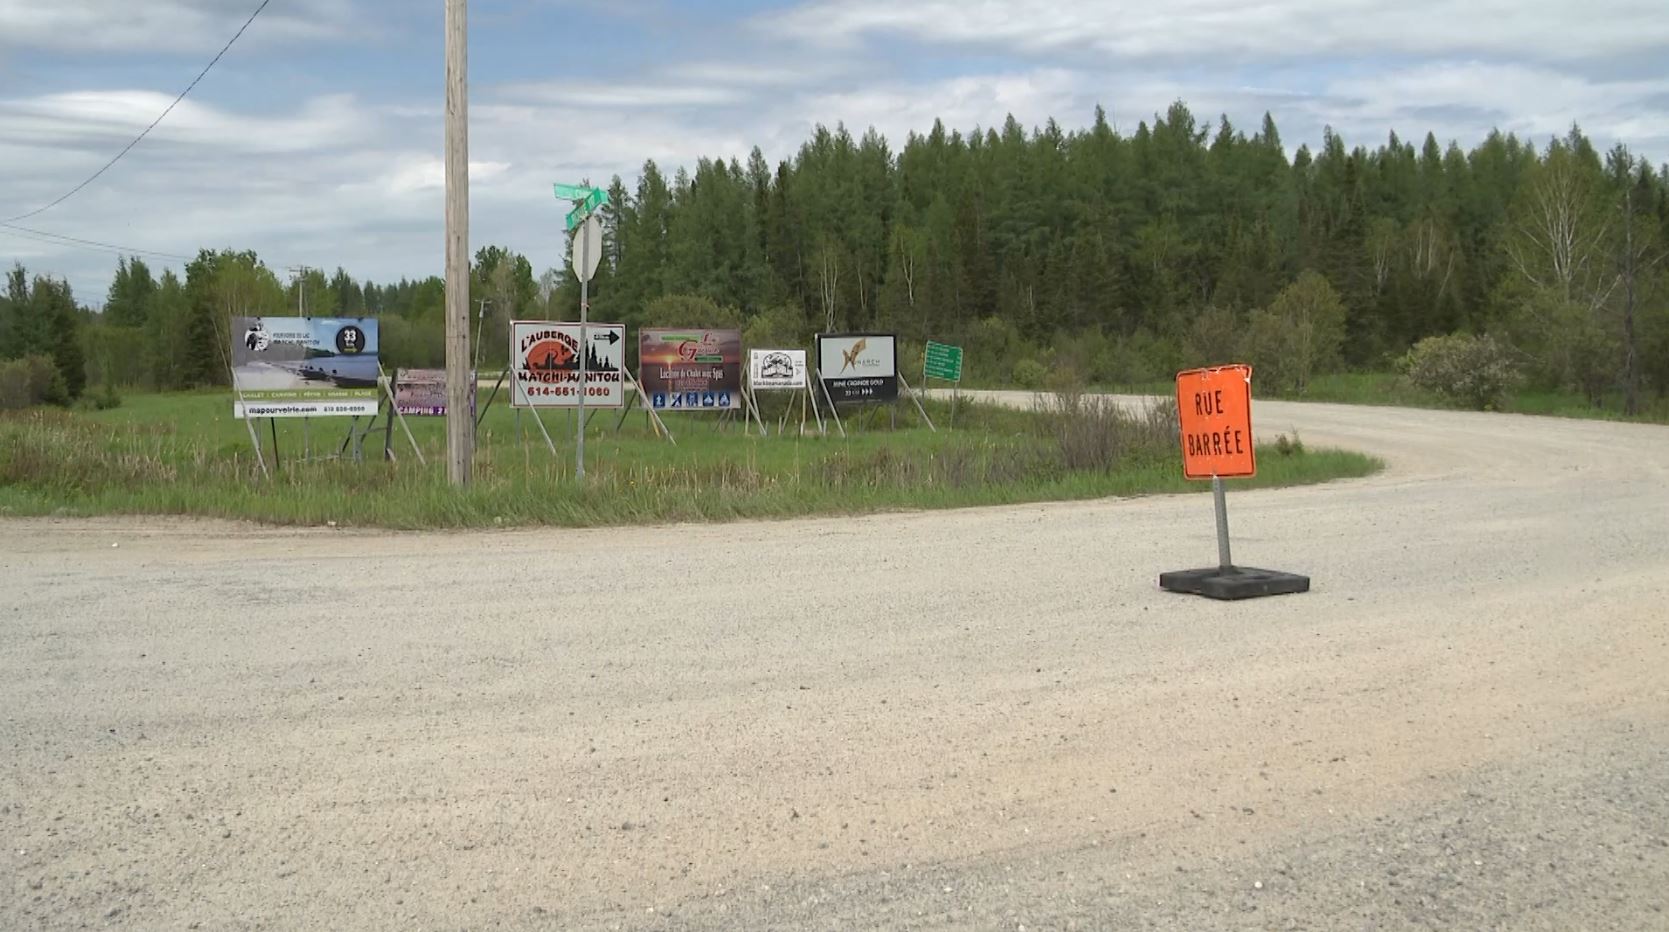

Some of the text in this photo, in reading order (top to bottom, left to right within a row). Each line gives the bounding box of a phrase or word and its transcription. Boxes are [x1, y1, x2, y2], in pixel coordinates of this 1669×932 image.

[344, 330, 357, 341] 33
[521, 330, 579, 353] L'AUBERGE
[399, 406, 434, 414] CAMPING
[1194, 390, 1223, 416] RUE
[1188, 425, 1243, 456] BARRÉE
